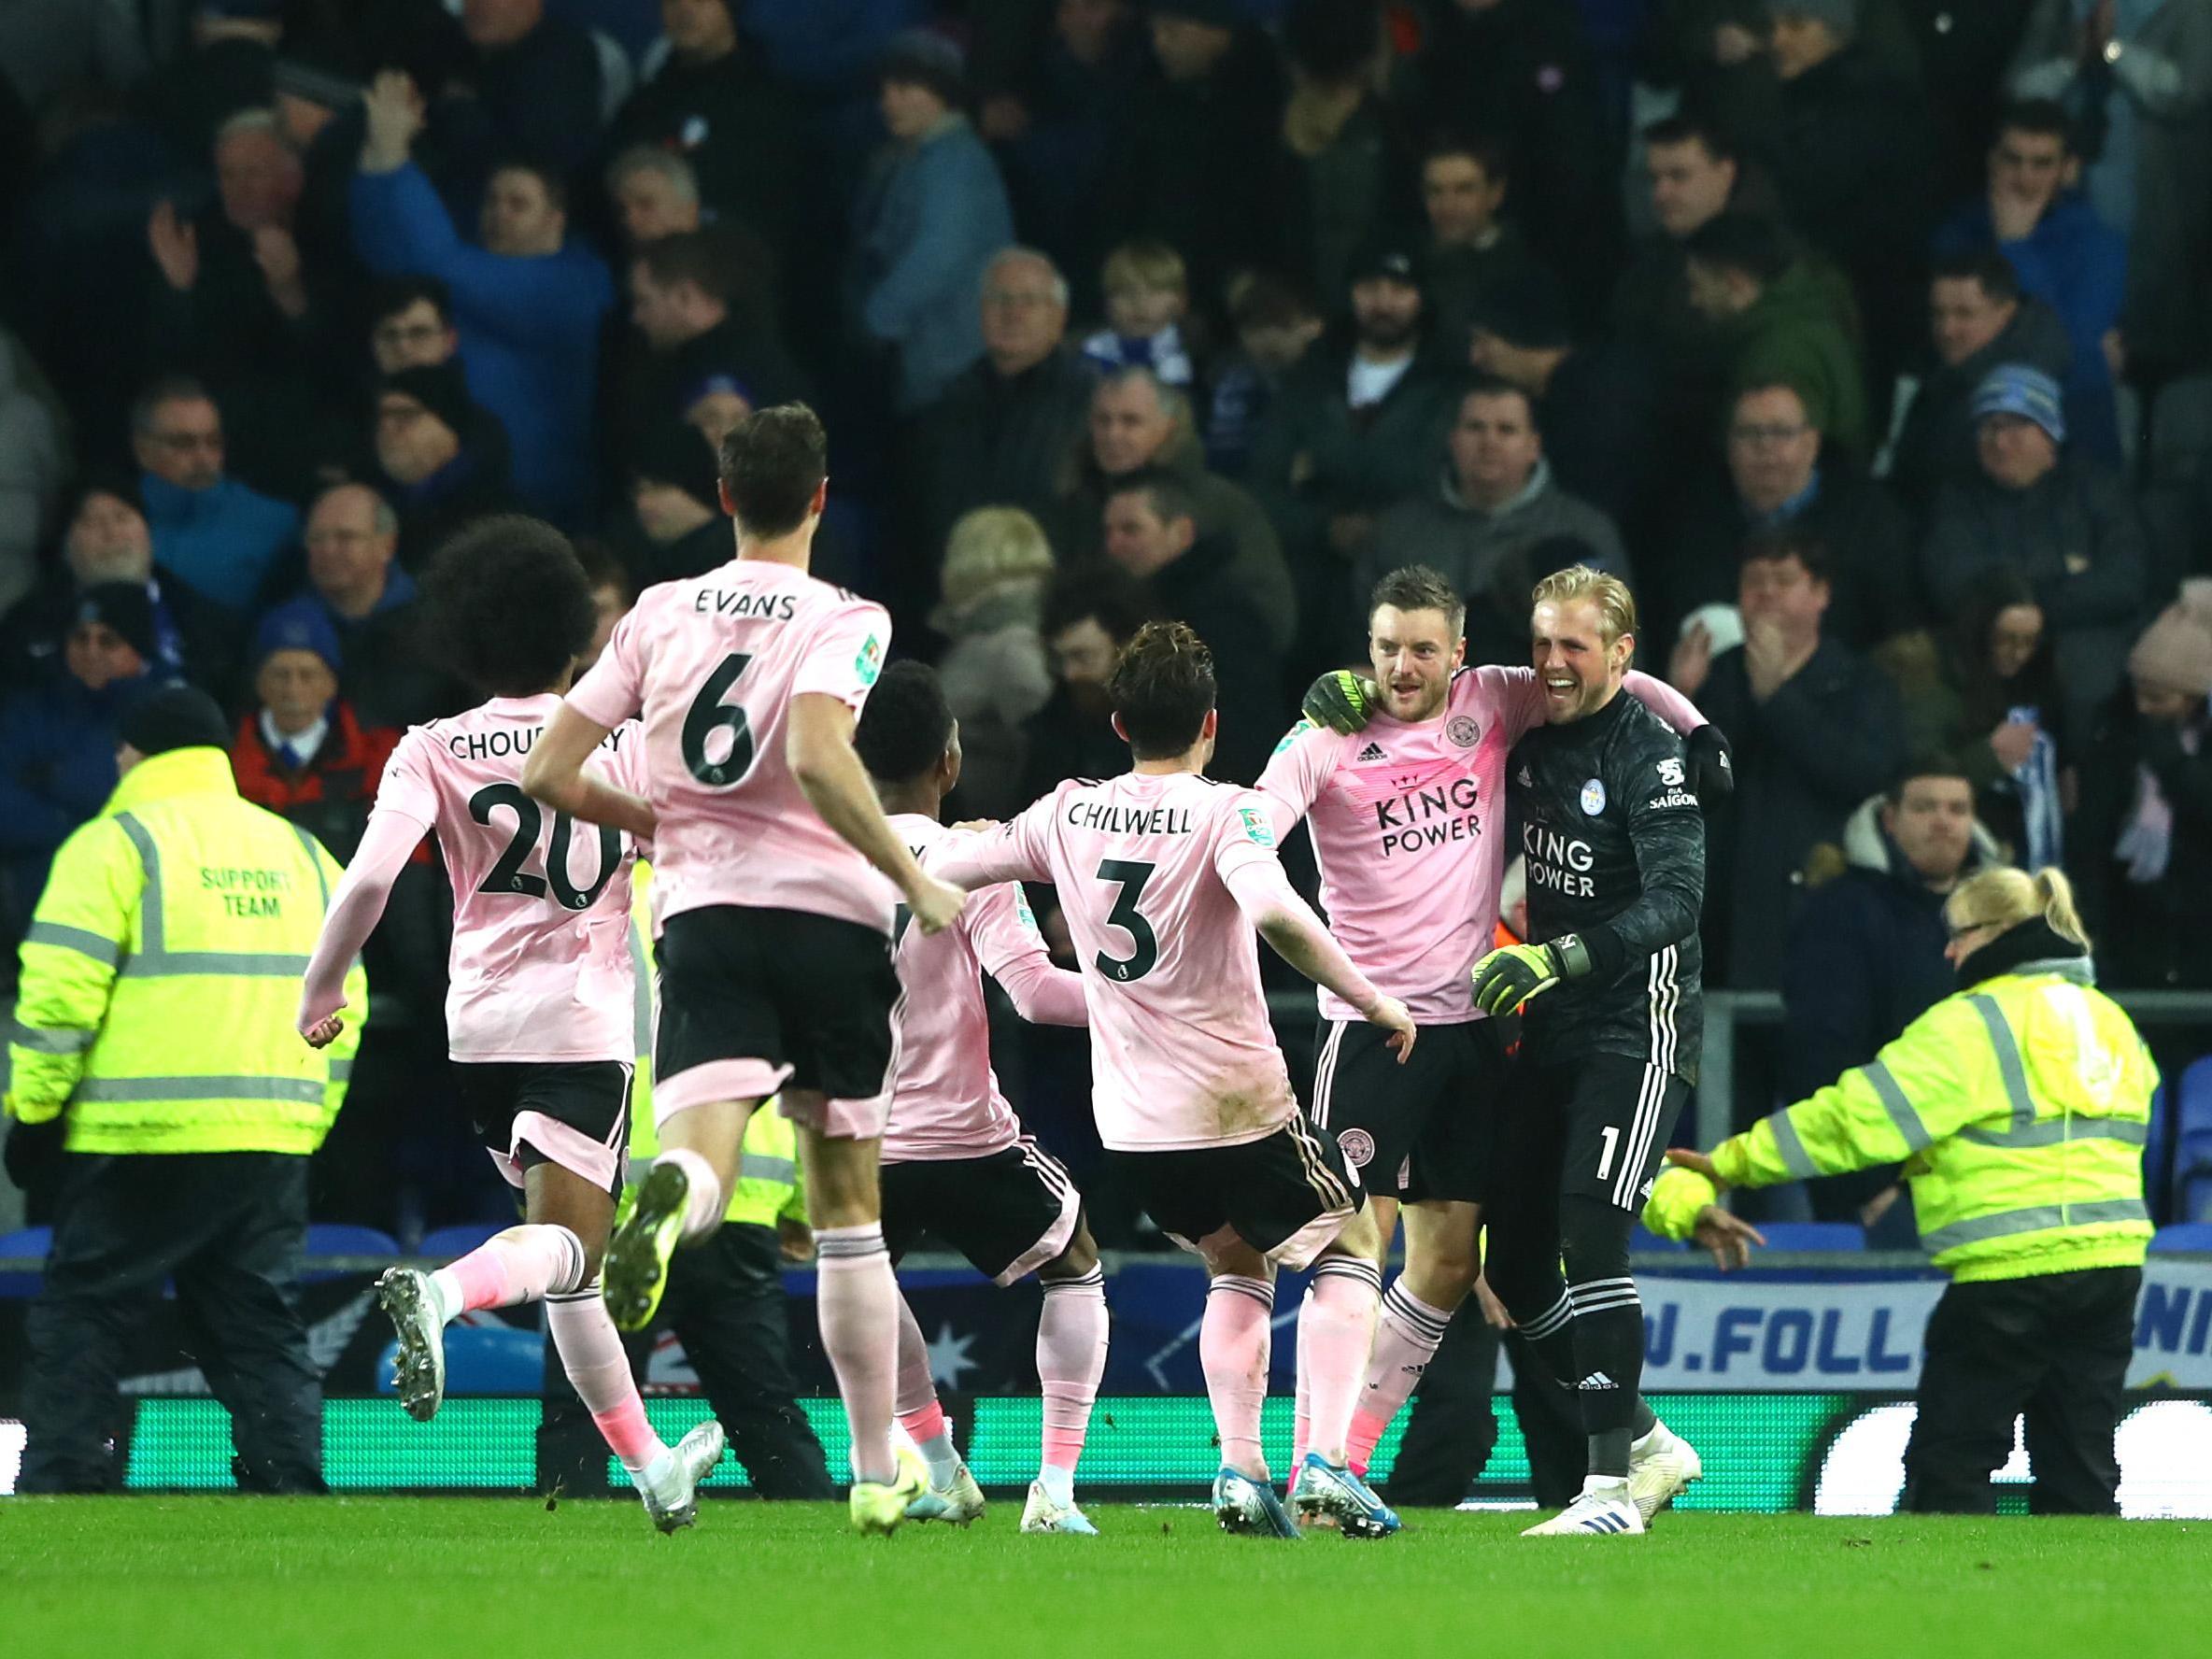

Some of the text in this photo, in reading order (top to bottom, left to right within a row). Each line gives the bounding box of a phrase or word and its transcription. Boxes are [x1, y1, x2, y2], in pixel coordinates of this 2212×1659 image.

[695, 588, 797, 620] EVANS
[682, 652, 755, 787] 6
[1068, 802, 1192, 836] CHILWELL
[1375, 778, 1478, 830] KING
[1649, 793, 1698, 810] SAIGON
[468, 782, 623, 912] 20
[1382, 815, 1482, 857] POWER
[1524, 821, 1594, 872] KING
[201, 866, 291, 891] SUPPORT
[223, 894, 281, 918] TEAM
[1096, 858, 1158, 984] 3
[1596, 1126, 1620, 1180] 1
